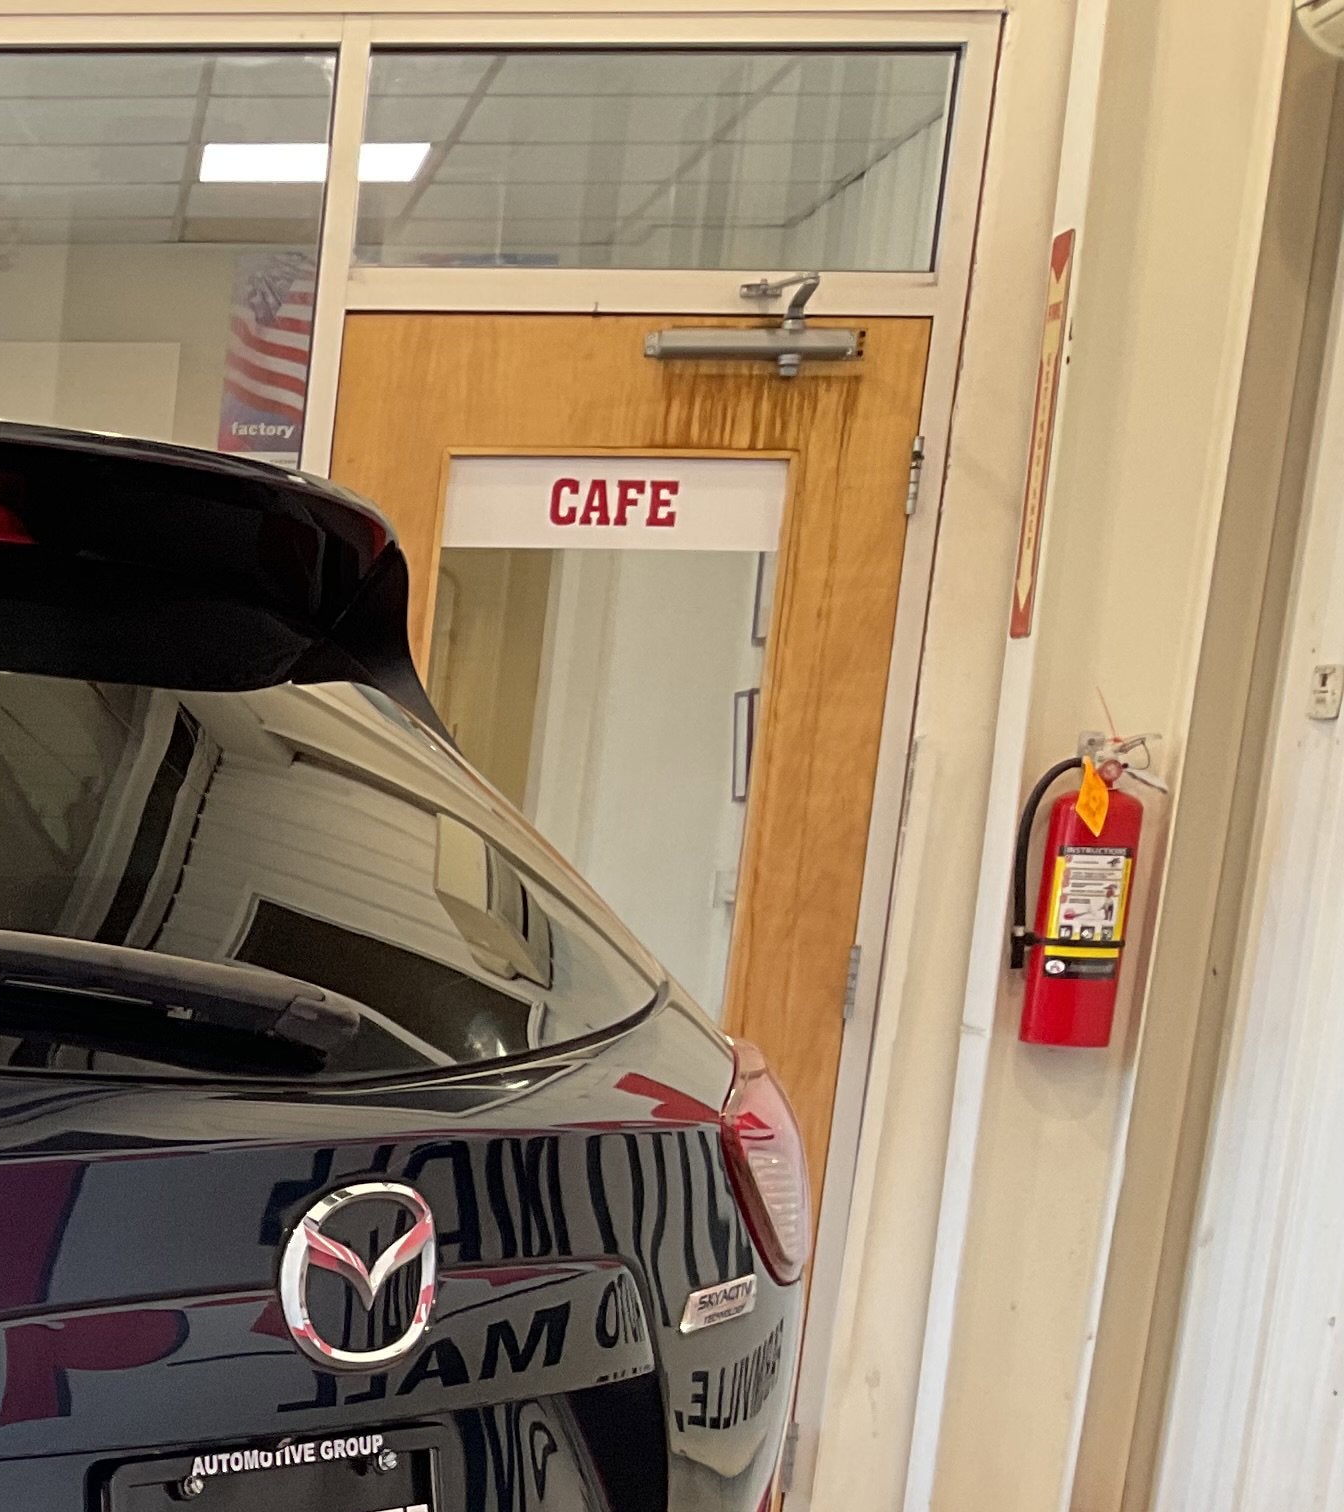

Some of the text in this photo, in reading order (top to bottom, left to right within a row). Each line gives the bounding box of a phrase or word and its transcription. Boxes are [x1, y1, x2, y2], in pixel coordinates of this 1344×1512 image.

[231, 421, 295, 439] factory
[549, 477, 680, 527] CAFE
[697, 1279, 753, 1311] SKYACTIV
[191, 1433, 384, 1477] AUTOMOTIVE GROUP
